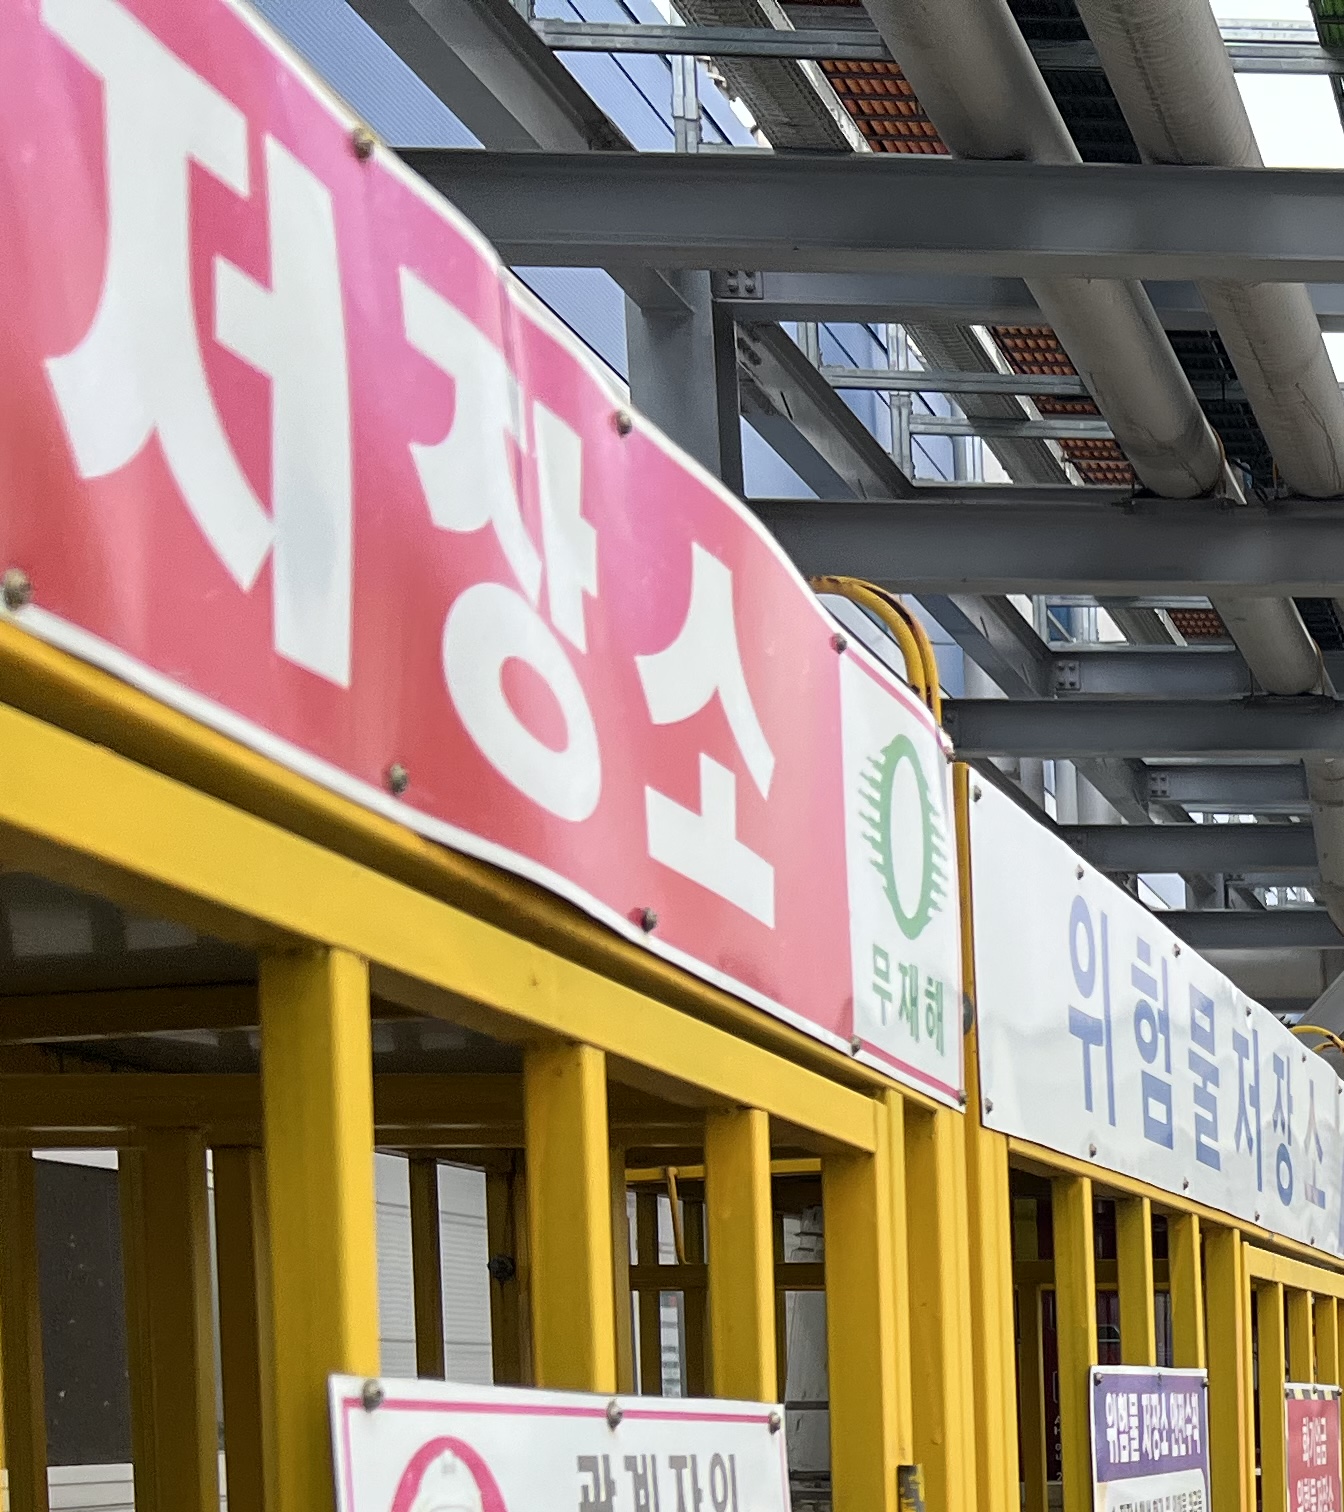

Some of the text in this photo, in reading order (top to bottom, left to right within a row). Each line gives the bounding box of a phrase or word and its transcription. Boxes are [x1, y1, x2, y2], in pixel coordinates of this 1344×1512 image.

[41, 0, 776, 930] 저장소
[872, 943, 944, 1056] 무재해
[1069, 895, 1326, 1210] 위험물저장소
[1105, 1392, 1200, 1464] 위험물 저장소 안전수칙
